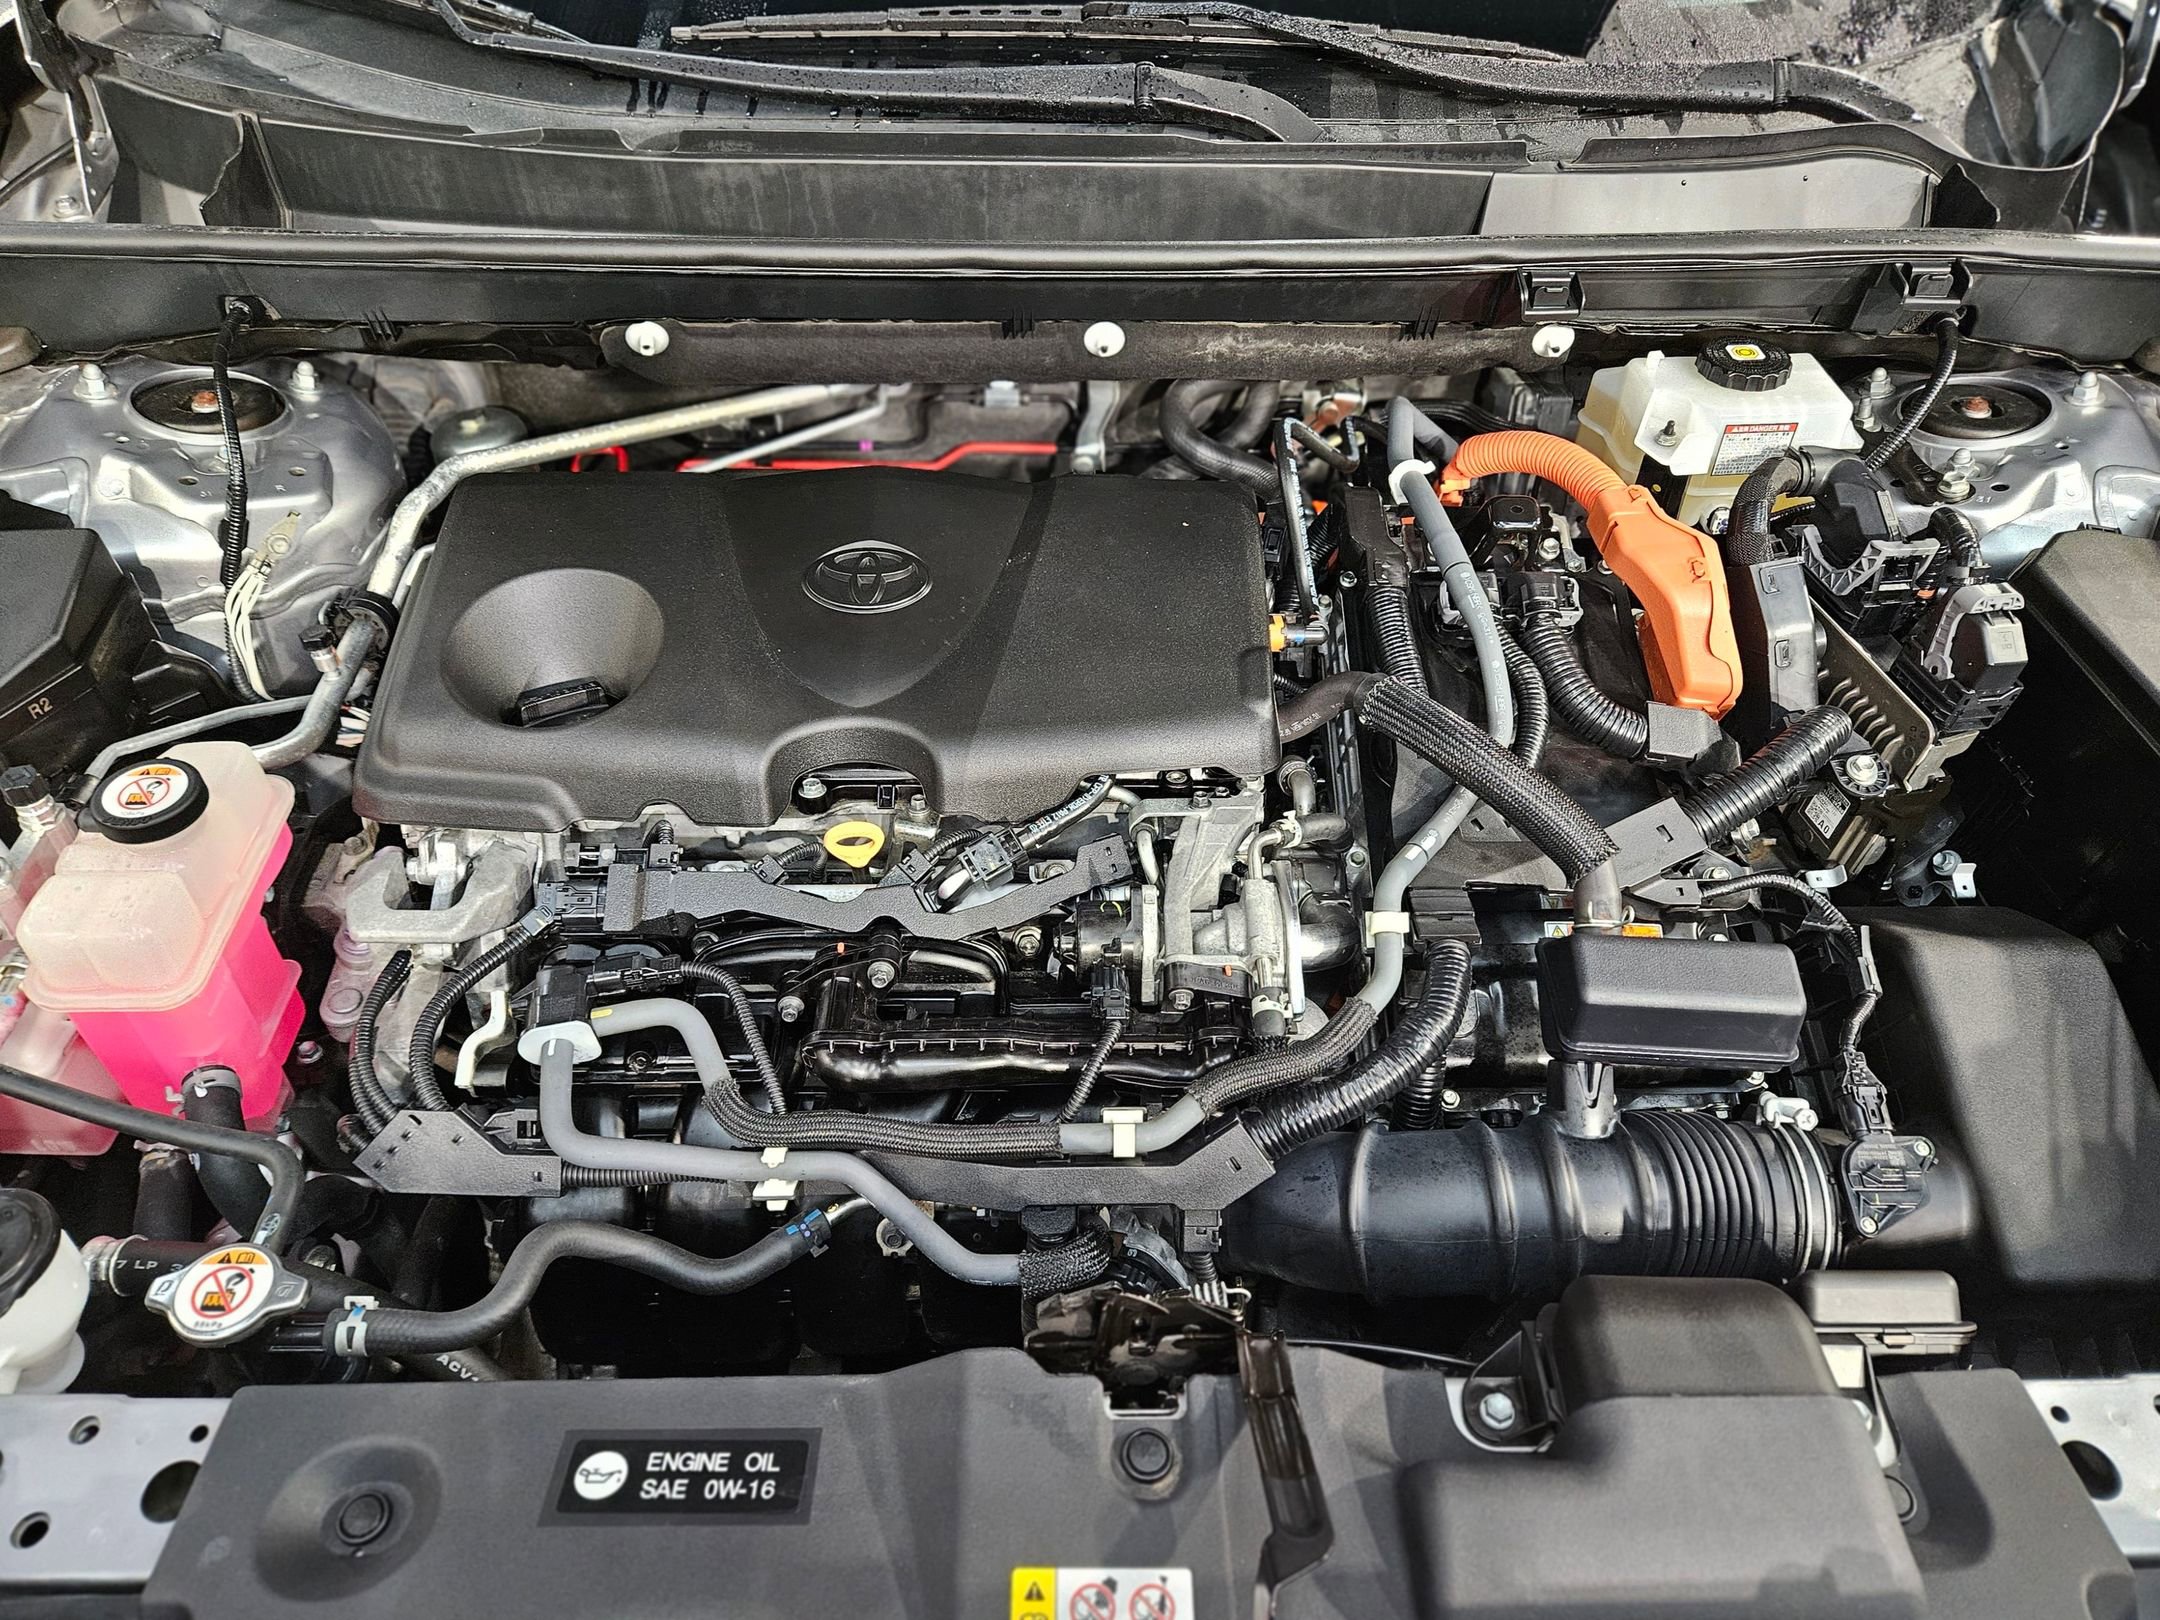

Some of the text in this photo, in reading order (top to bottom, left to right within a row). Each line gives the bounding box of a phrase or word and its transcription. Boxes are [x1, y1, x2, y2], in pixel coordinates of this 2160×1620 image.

[27, 697, 53, 719] R2
[134, 1261, 158, 1270] LP
[646, 1452, 781, 1472] ENGINE OIL
[639, 1479, 777, 1500] SAE 0W-16
